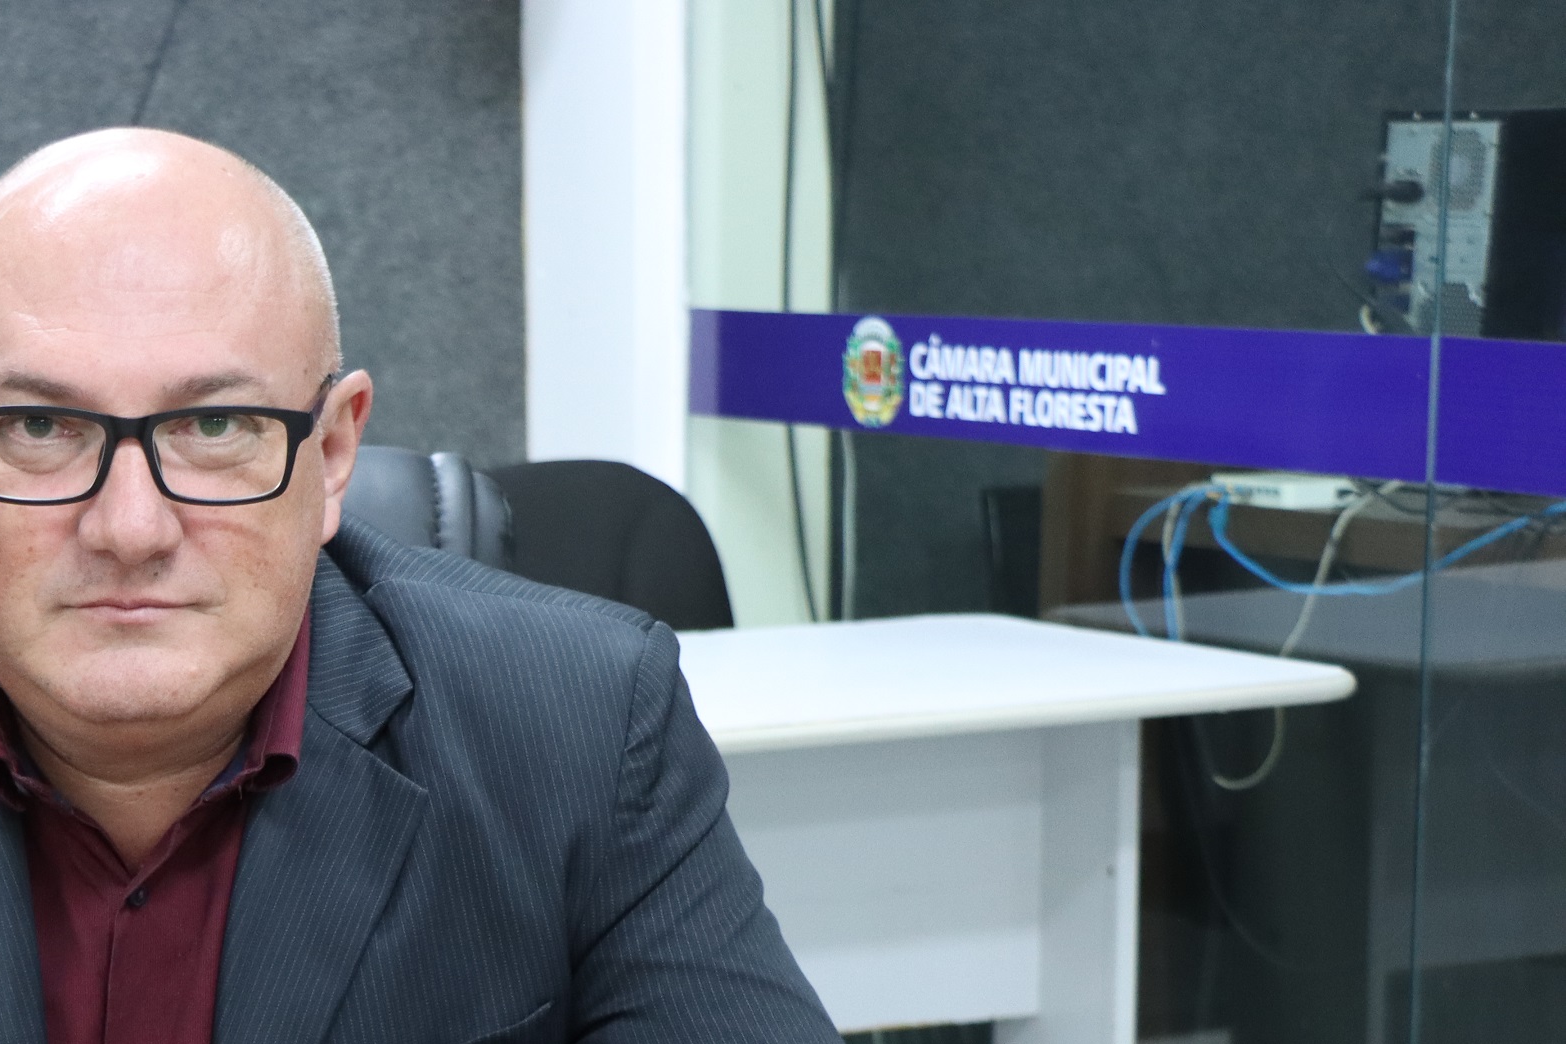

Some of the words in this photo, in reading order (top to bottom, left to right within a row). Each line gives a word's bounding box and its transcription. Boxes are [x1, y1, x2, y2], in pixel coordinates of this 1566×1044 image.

[909, 332, 1016, 385] CÂMARA
[1018, 349, 1167, 395] MUNICIPAL
[909, 382, 945, 419] DE
[945, 385, 1008, 424] ALTA
[1009, 387, 1139, 435] FLORESTA
